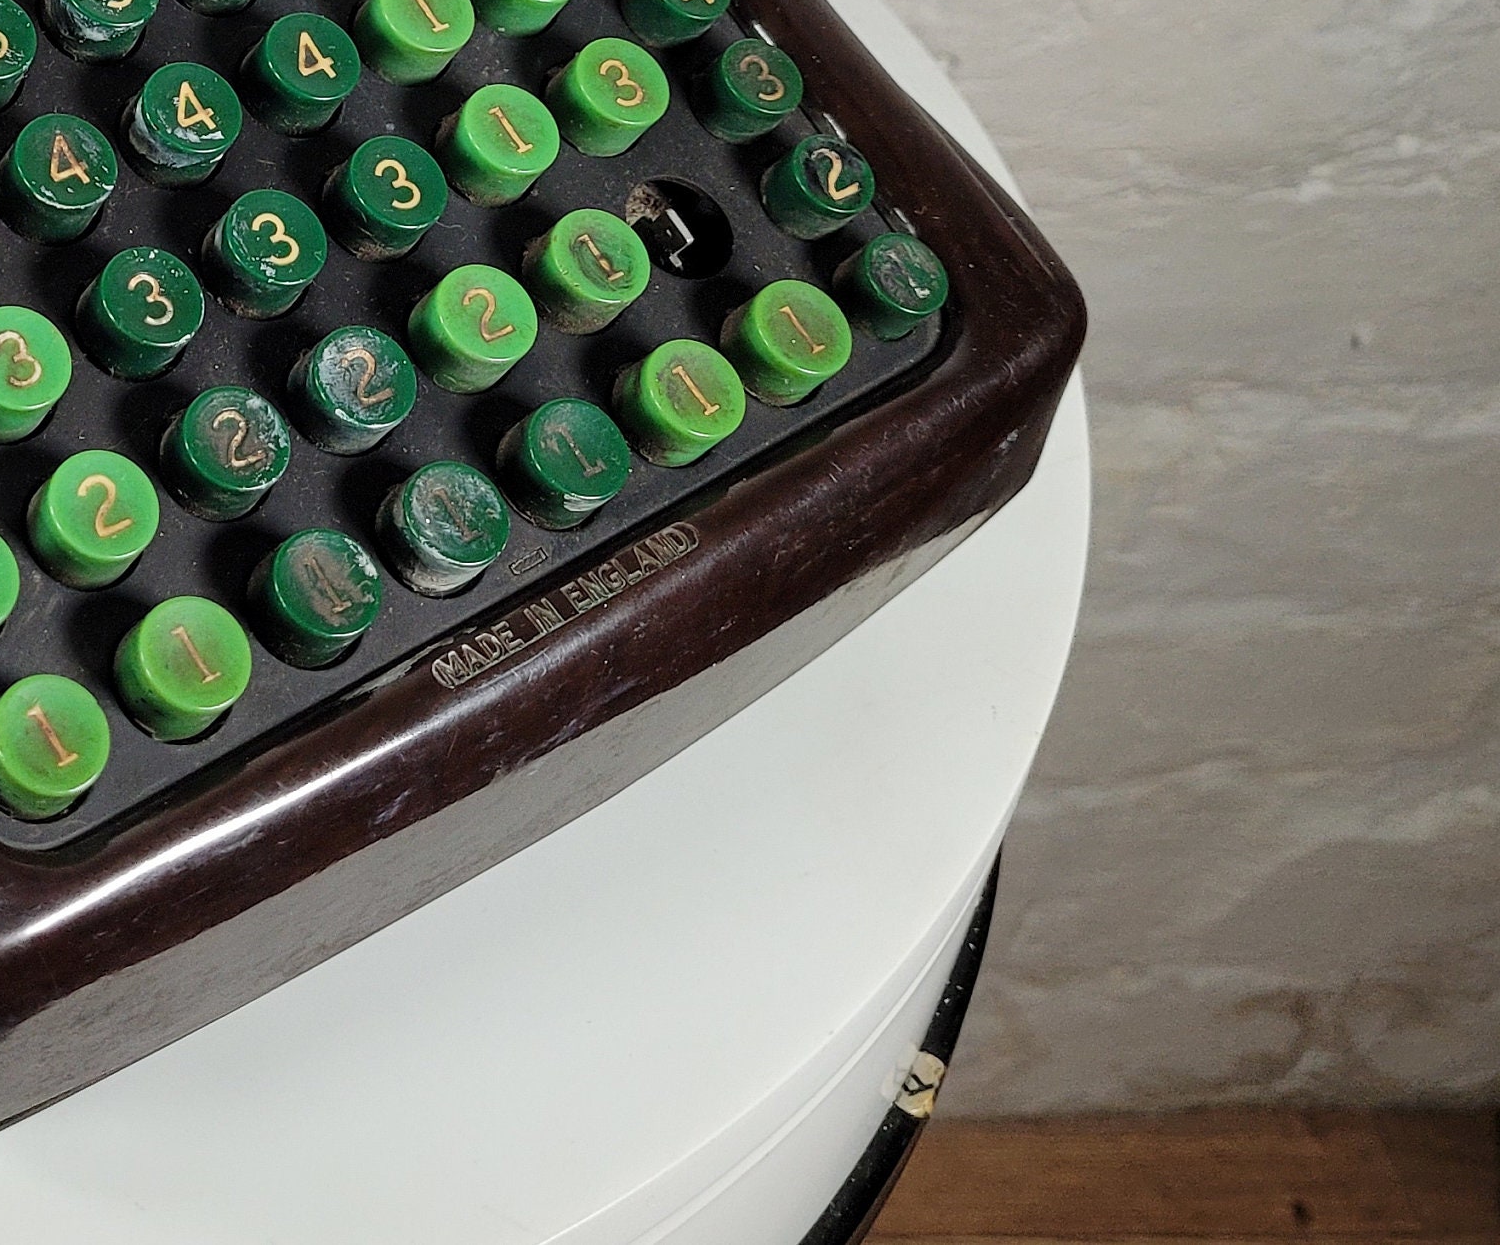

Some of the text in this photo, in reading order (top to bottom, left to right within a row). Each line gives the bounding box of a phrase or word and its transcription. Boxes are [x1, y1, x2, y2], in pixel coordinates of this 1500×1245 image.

[298, 32, 336, 79] 4
[740, 55, 785, 101] 3
[176, 81, 217, 130] 4
[600, 59, 645, 108] 3
[488, 106, 533, 154] 1
[49, 132, 90, 184] 4
[375, 159, 421, 209] 3
[811, 147, 862, 201] 2
[252, 213, 299, 266] 3
[578, 233, 625, 281] 1
[127, 272, 174, 326] 3
[462, 287, 515, 343] 2
[779, 305, 825, 354] 1
[340, 347, 394, 407] 2
[671, 365, 720, 416] 1
[212, 407, 269, 469] 2
[77, 474, 134, 538] 2
[433, 486, 483, 542] 1
[304, 555, 352, 614] 1
[438, 526, 692, 686] MADE IN ENGLAND
[171, 626, 221, 684] 1
[27, 704, 78, 768] 1
